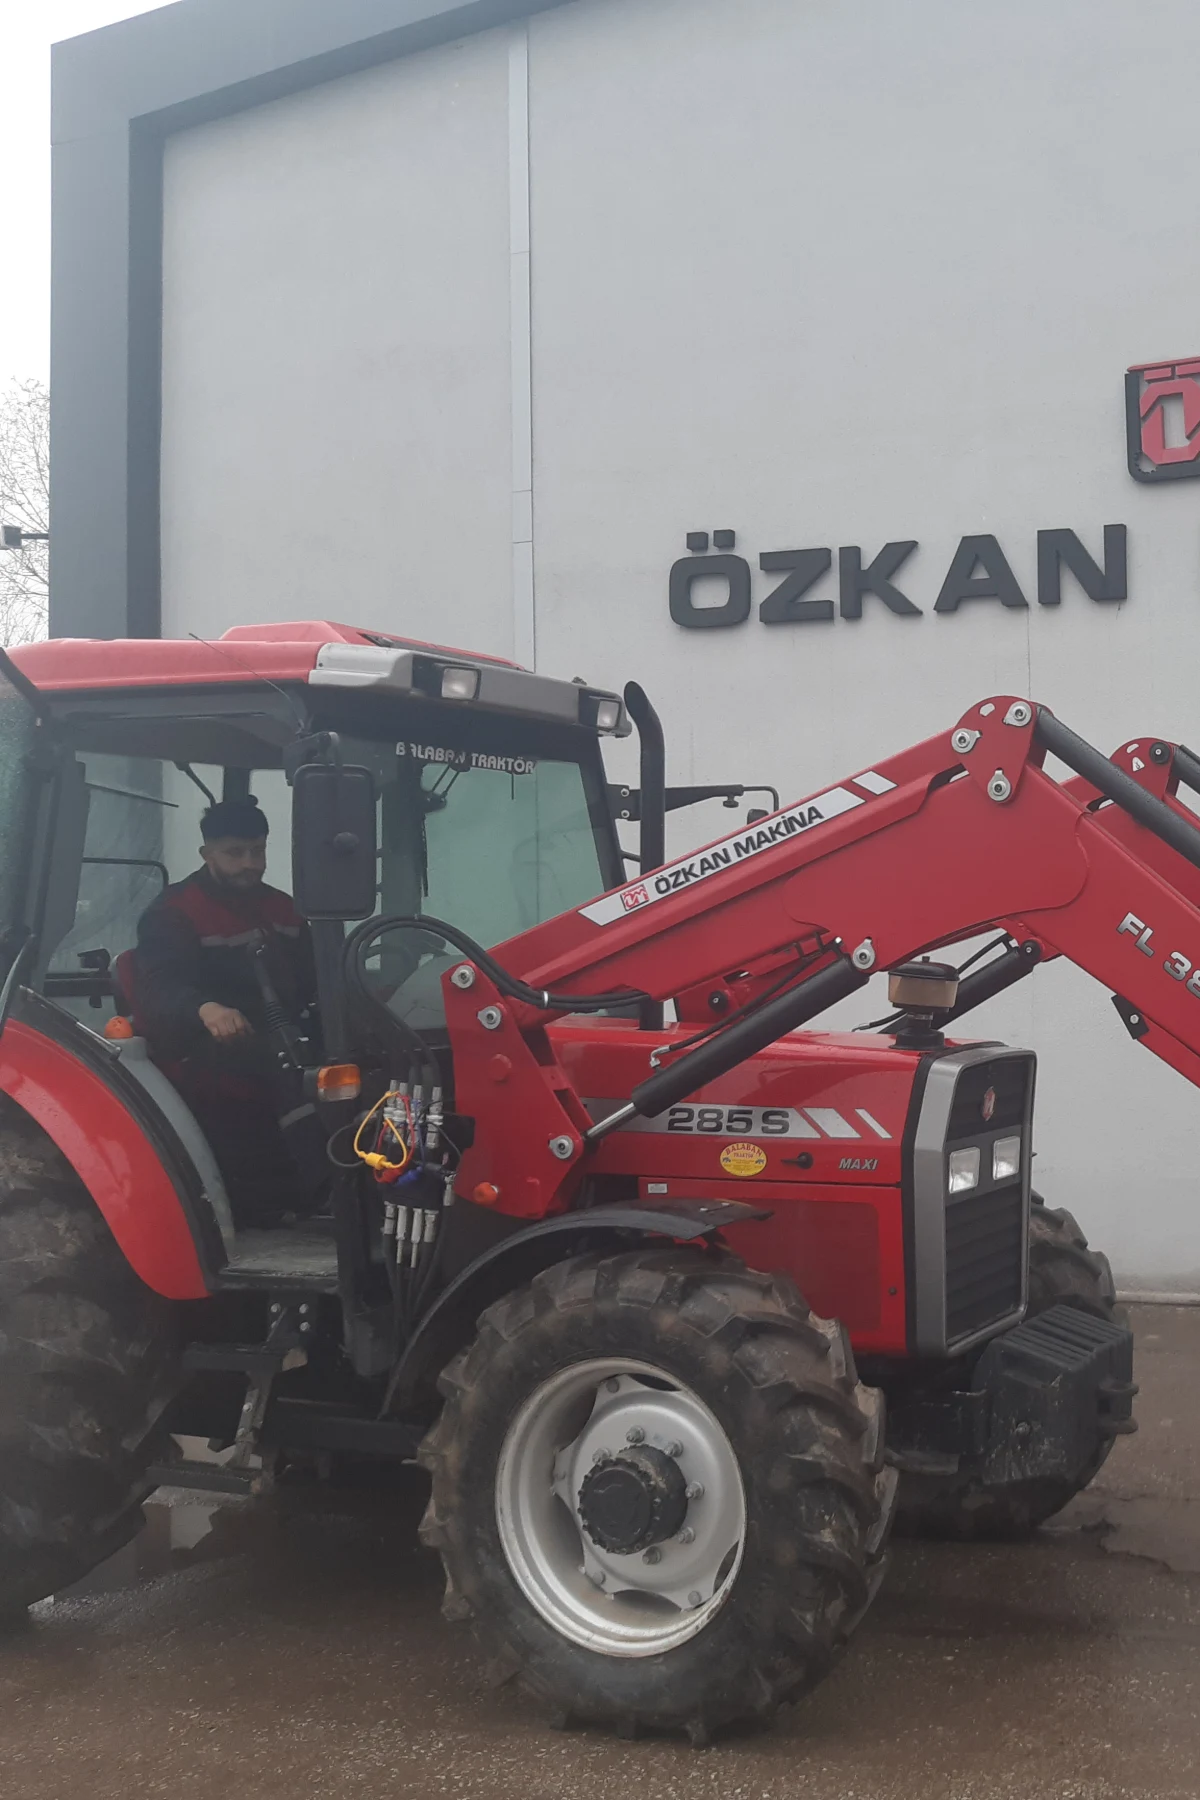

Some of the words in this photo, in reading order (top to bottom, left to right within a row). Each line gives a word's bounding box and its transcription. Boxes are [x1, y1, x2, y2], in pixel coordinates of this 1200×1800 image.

[668, 524, 1127, 628] ÖZKAN
[471, 753, 534, 774] TRAKTÖR
[654, 847, 732, 895] ÖZKAN
[733, 805, 825, 858] MAKİNA
[1116, 911, 1155, 958] FL
[838, 1157, 879, 1170] MAXI
